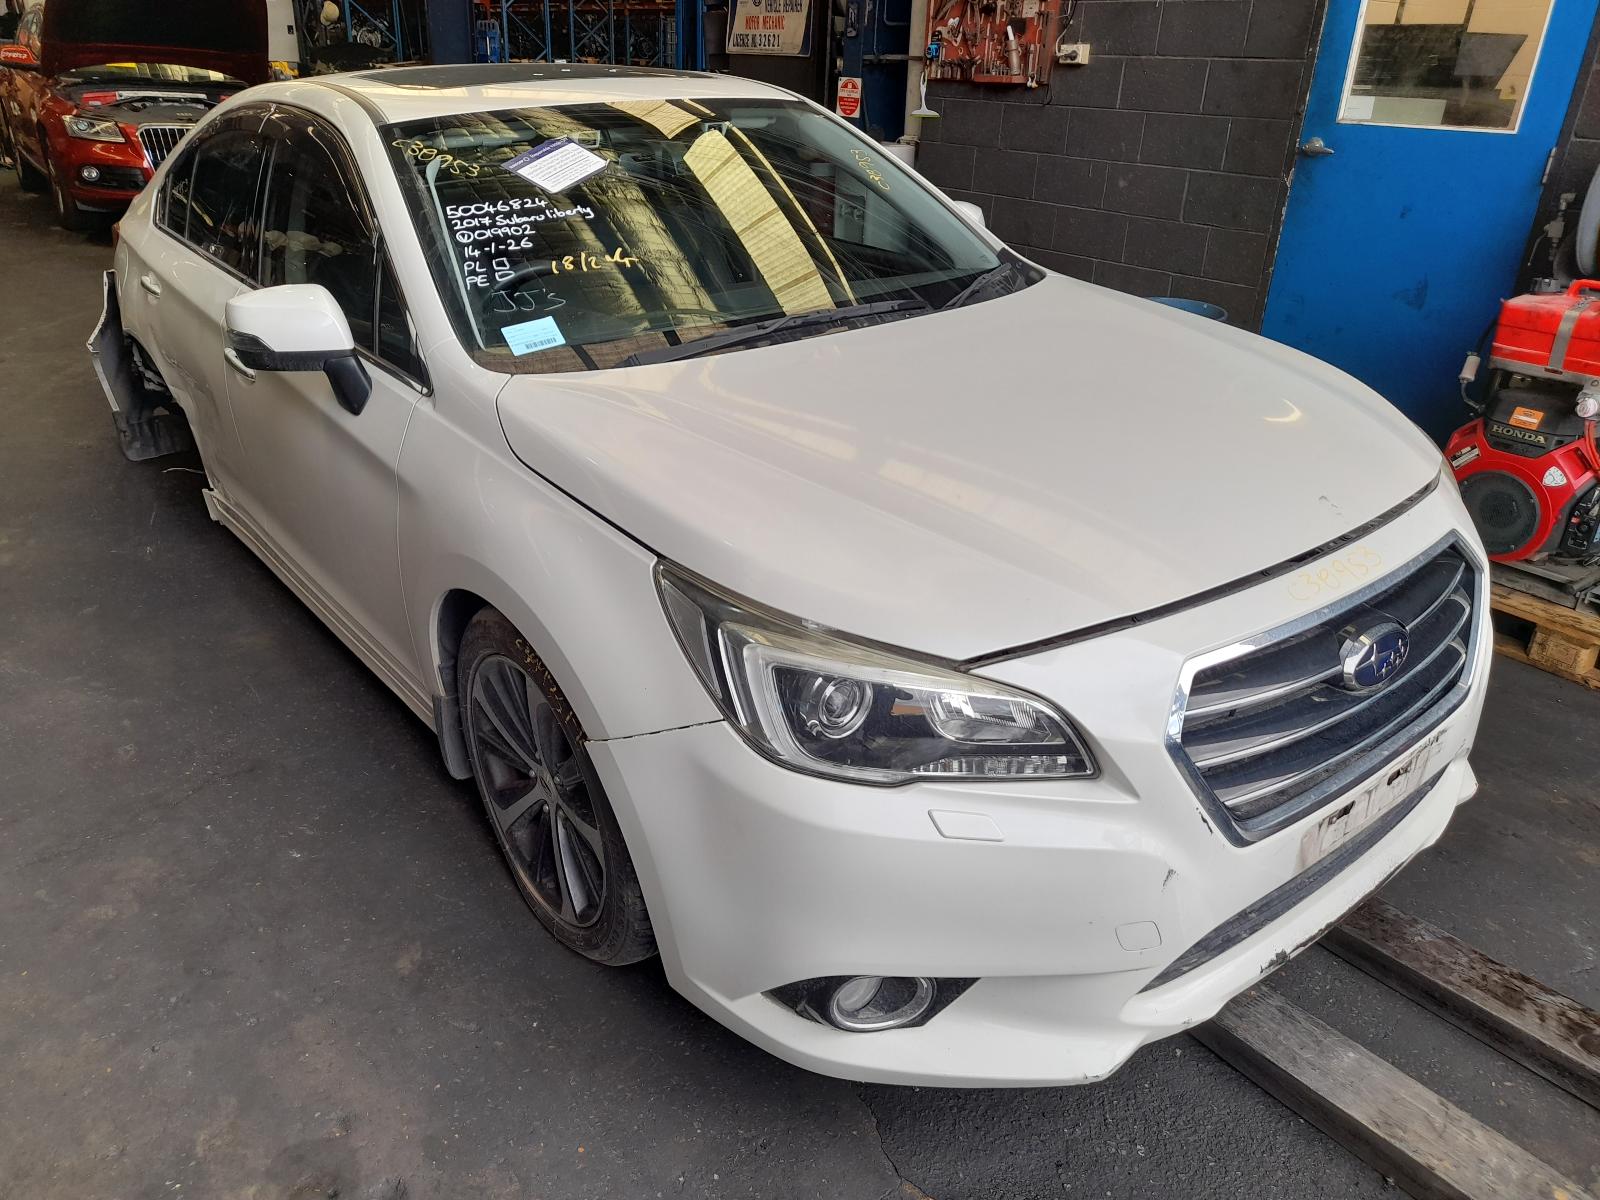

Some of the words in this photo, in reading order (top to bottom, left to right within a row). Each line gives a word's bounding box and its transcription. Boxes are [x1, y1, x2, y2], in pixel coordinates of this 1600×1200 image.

[745, 16, 760, 30] MOTOR
[763, 15, 785, 30] MECHANIC
[758, 33, 780, 47] 32621
[446, 197, 548, 219] 50046824
[451, 217, 492, 230] 2017
[496, 213, 545, 226] Subaru
[464, 261, 486, 276] PL
[466, 275, 490, 290] PE
[1491, 424, 1546, 444] HONDA
